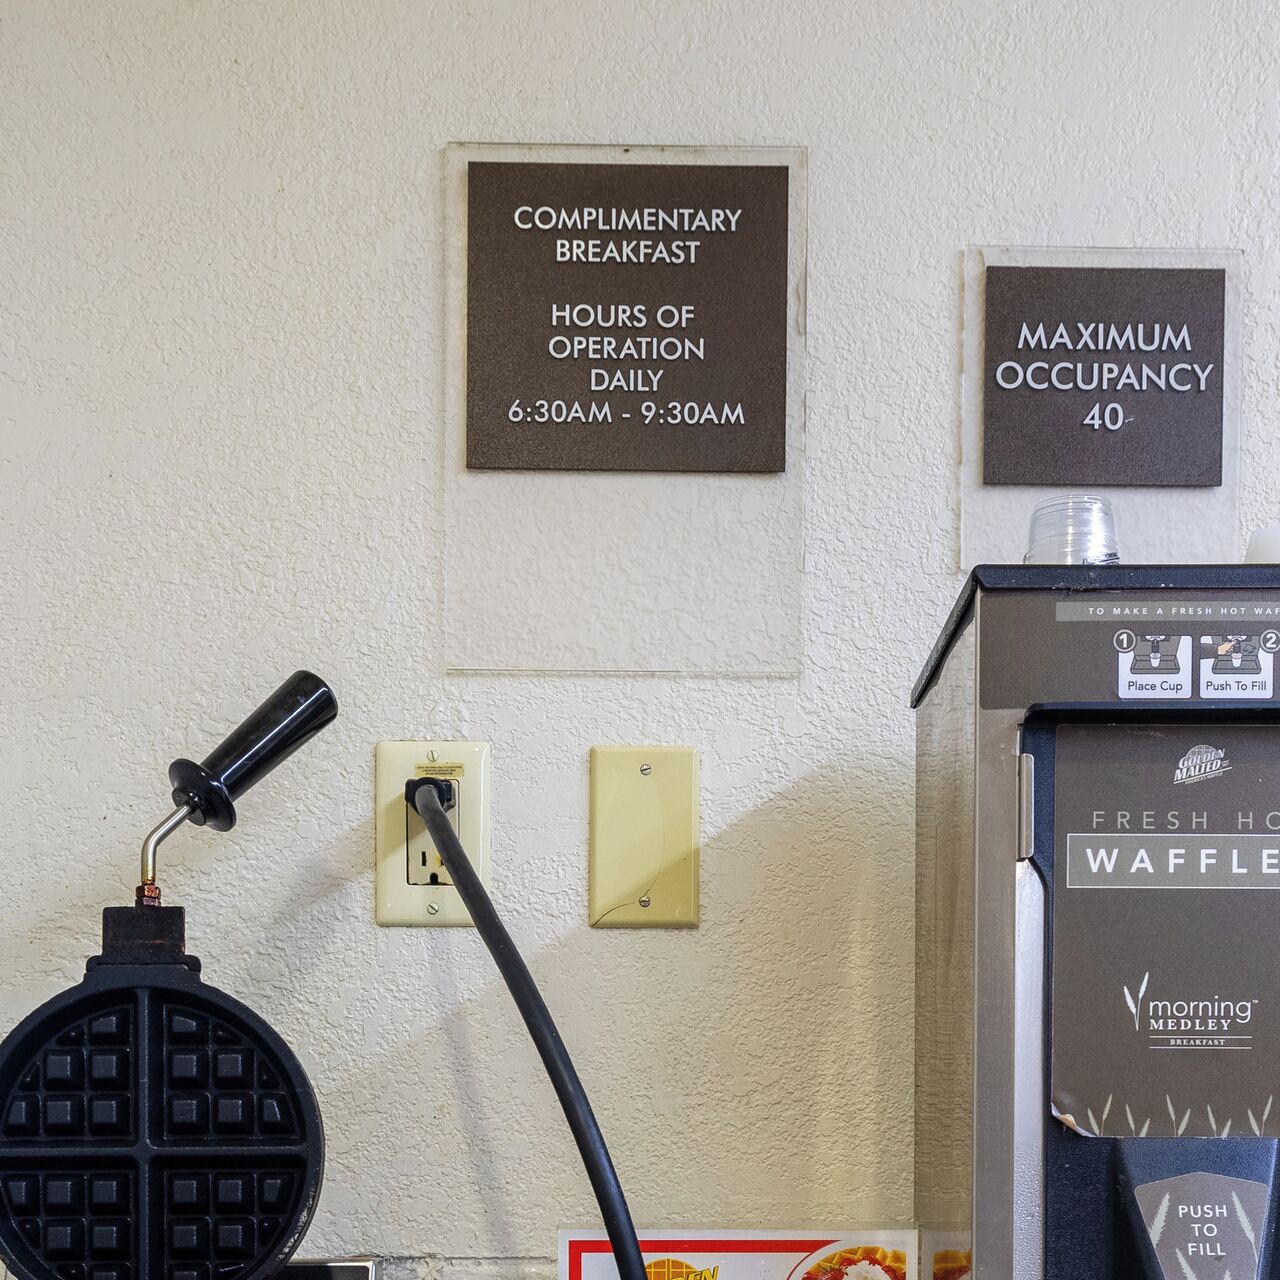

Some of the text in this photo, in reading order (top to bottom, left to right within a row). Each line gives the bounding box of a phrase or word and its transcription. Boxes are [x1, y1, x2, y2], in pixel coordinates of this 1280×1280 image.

[513, 205, 743, 232] COMPLIMENTARY
[555, 239, 701, 264] BREAKFAST
[551, 303, 695, 329] HOURS OF
[1017, 321, 1192, 351] MAXIMUM
[548, 335, 705, 361] OPERATION
[590, 368, 664, 393] DAILY
[995, 360, 1214, 392] OCCUPANCY
[508, 399, 613, 424] 6:30AM
[640, 401, 746, 425] 9:30AM
[1082, 402, 1125, 431] 40
[1088, 606, 1105, 616] TO
[1113, 606, 1149, 616] MAKE
[1156, 606, 1165, 616] A
[1171, 606, 1213, 616] FRESH
[1220, 606, 1247, 616] HOT
[1127, 680, 1183, 694] Place Cup
[1206, 679, 1267, 692] Push To Fill
[1178, 748, 1225, 769] GOLDEN
[1174, 759, 1221, 781] MALTED
[1092, 810, 1208, 830] FRESH
[1149, 1018, 1232, 1031] MEDLEY
[1170, 1038, 1226, 1046] BREAKFAST
[1178, 1204, 1228, 1218] PUSH
[1190, 1223, 1218, 1237] TO
[1187, 1242, 1227, 1256] FILL
